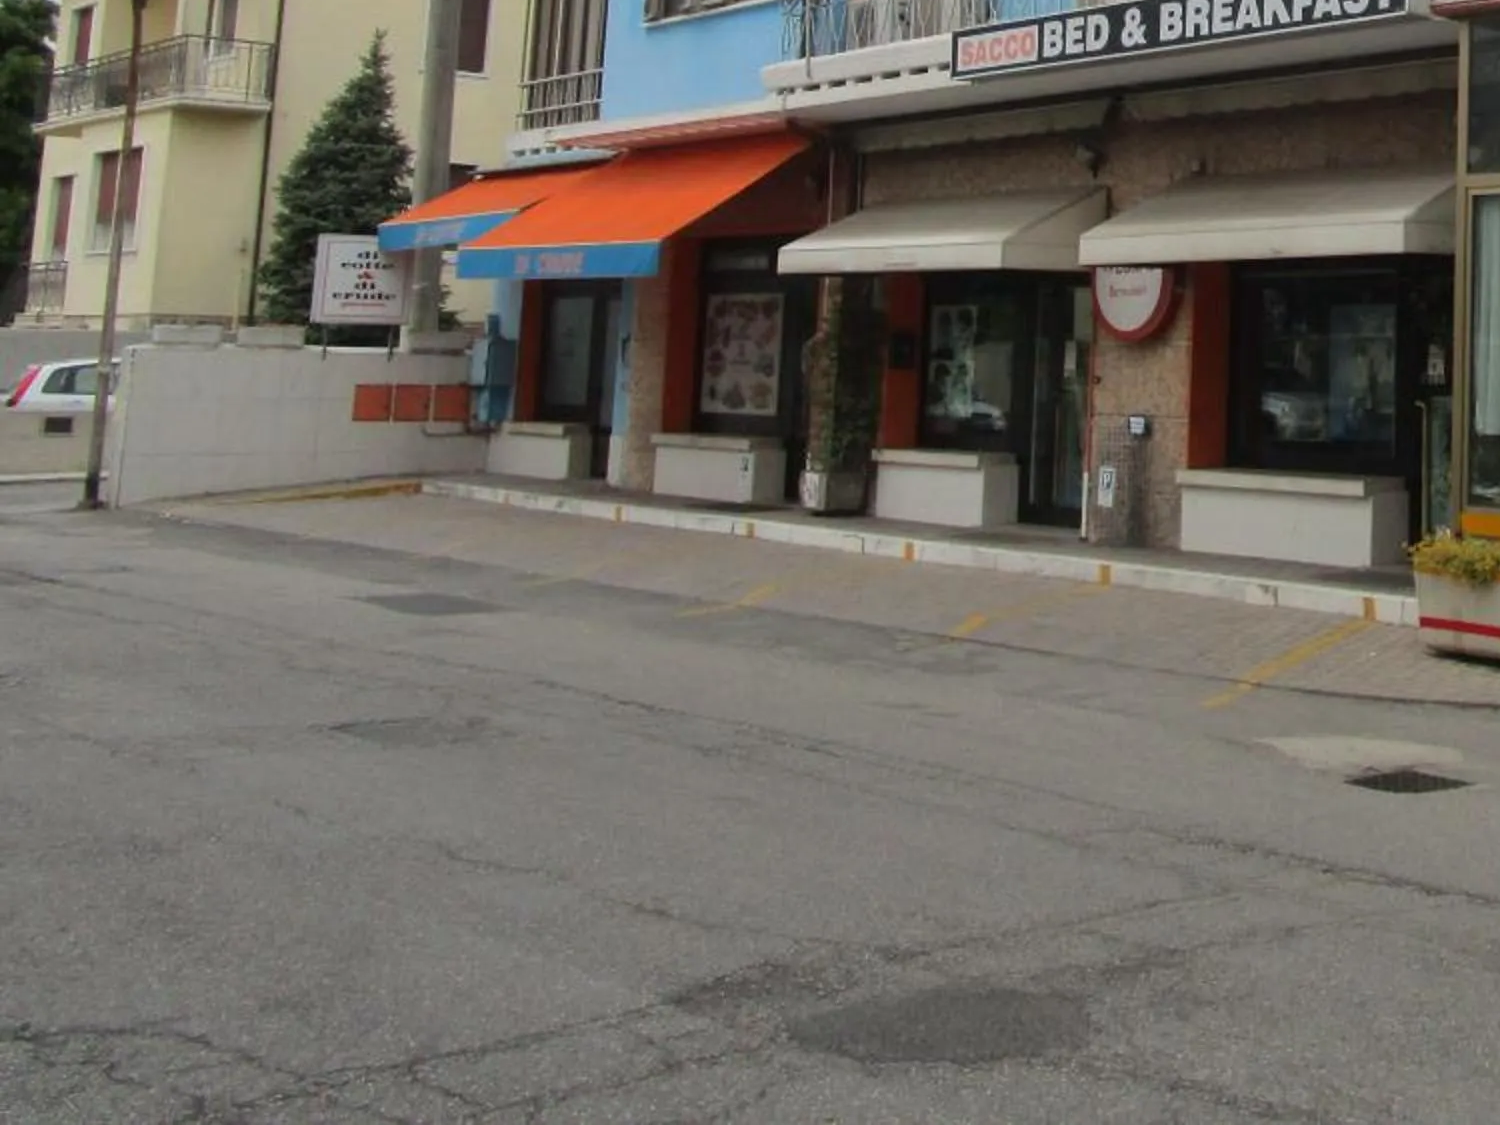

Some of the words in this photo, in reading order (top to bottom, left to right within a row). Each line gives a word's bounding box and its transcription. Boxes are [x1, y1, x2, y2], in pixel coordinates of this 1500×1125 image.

[961, 32, 1034, 67] SACCO
[1043, 14, 1110, 58] BED
[1121, 7, 1147, 49] &
